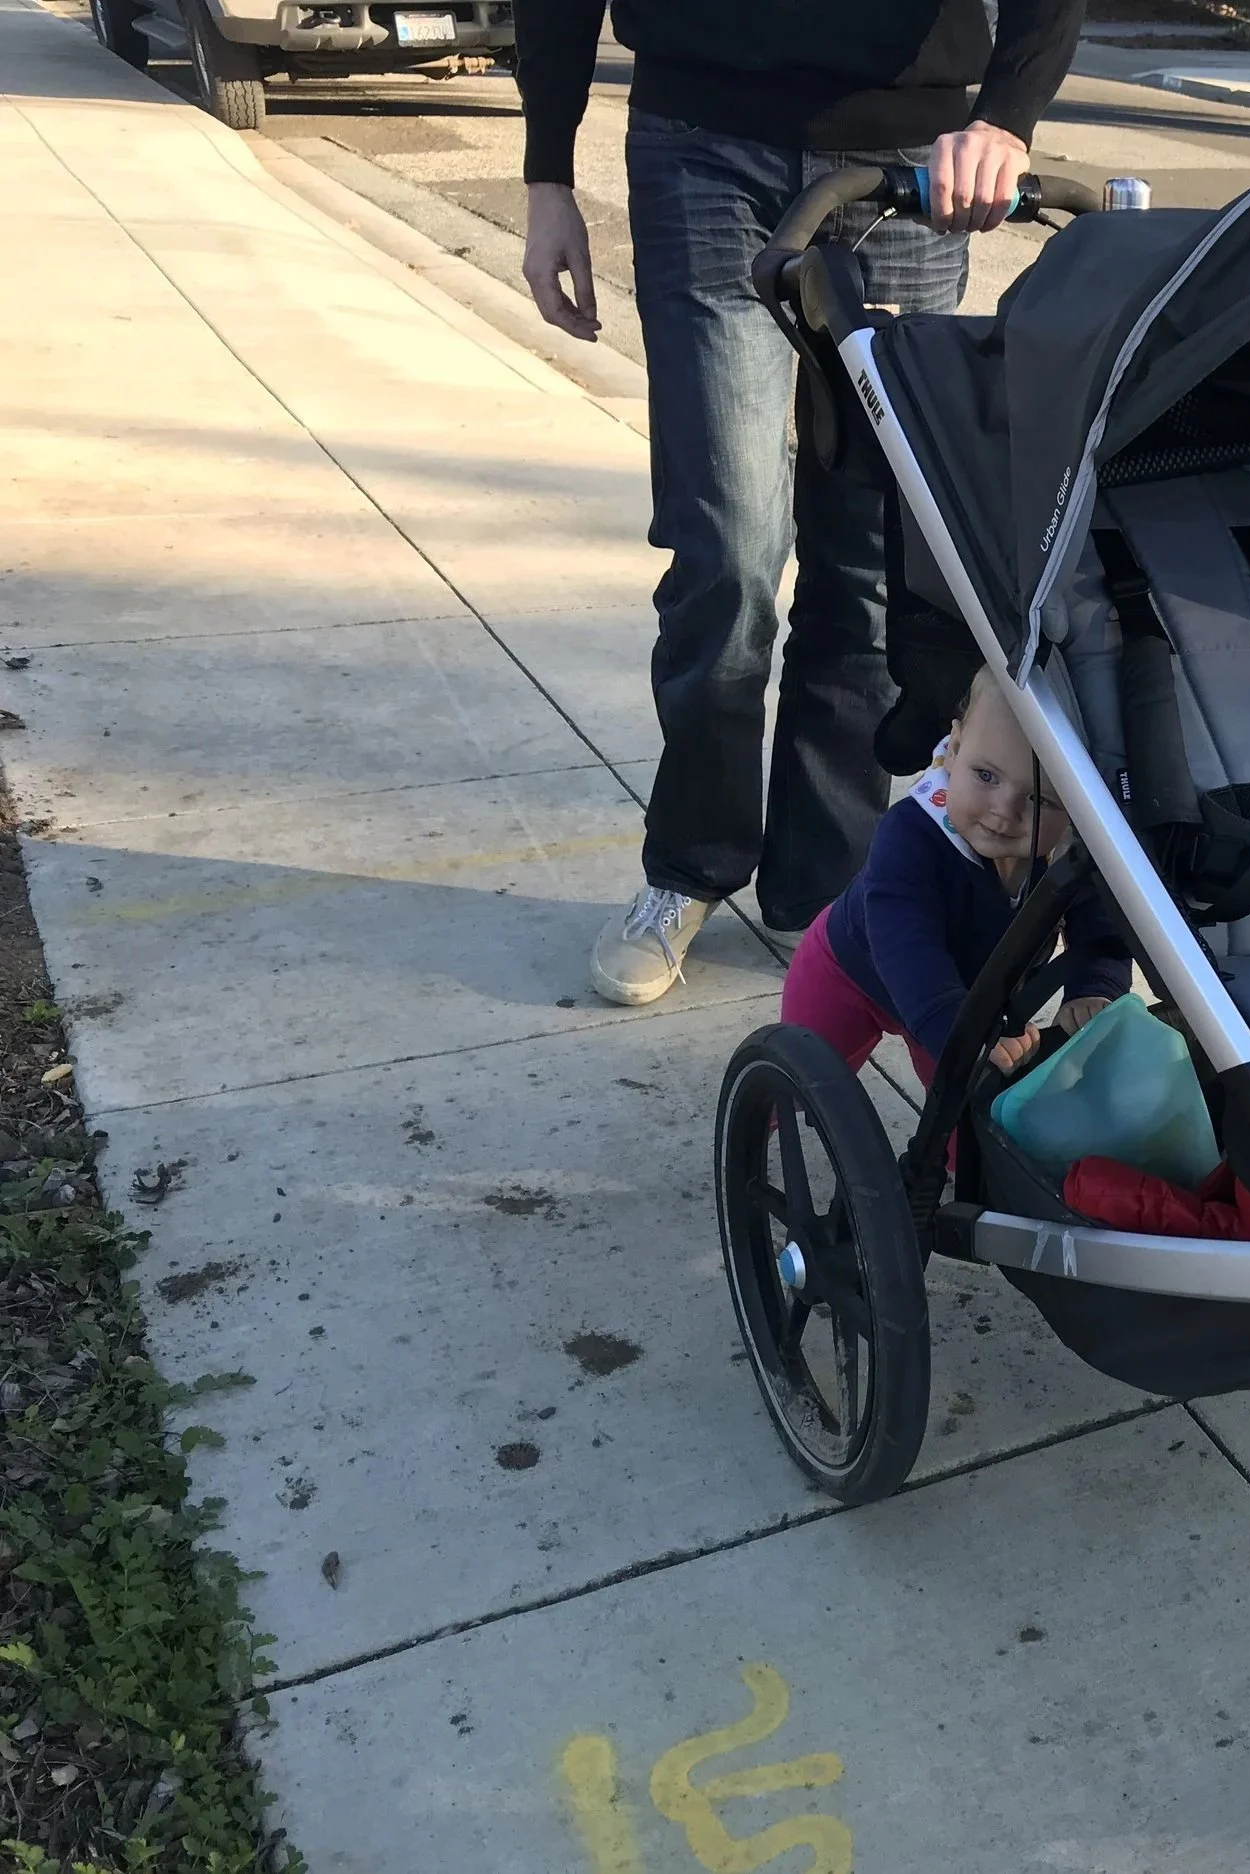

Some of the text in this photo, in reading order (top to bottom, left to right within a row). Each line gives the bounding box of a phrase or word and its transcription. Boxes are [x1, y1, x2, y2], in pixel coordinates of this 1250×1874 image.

[857, 368, 886, 426] THULE
[1040, 466, 1072, 552] Urban Glide
[1119, 771, 1132, 800] THULE
